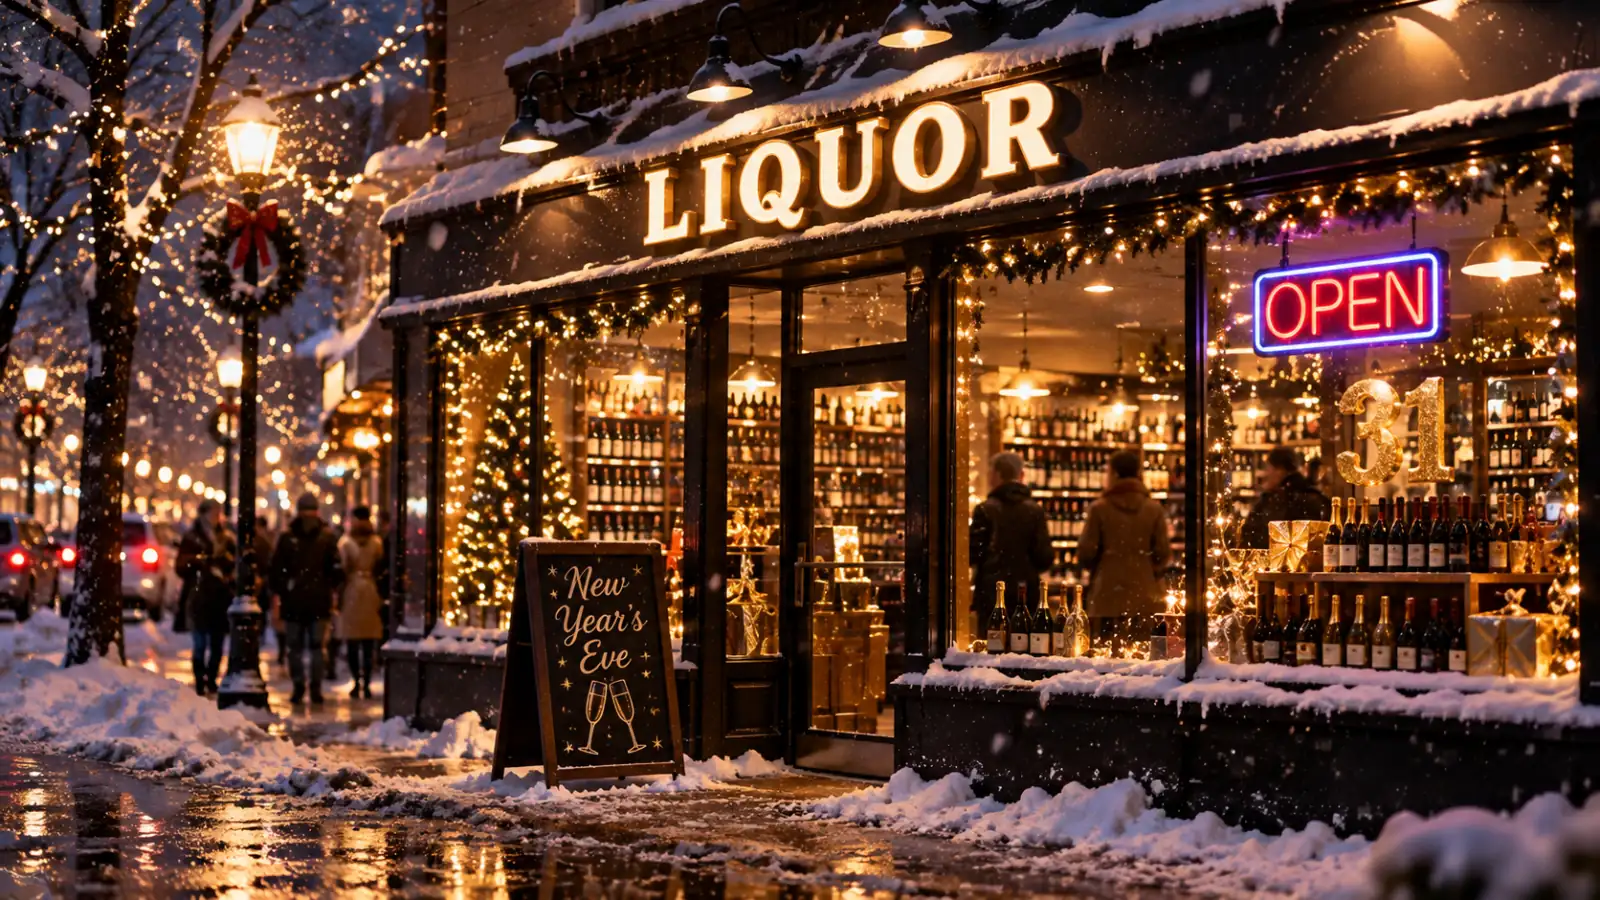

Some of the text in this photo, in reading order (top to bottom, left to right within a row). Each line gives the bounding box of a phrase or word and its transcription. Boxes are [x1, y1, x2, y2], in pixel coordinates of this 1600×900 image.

[643, 80, 1061, 246] LIQUOR
[1265, 265, 1425, 339] OPEN
[1335, 376, 1455, 487] 31
[563, 565, 629, 601] New
[554, 603, 648, 647] Year's
[579, 639, 632, 675] Eve
